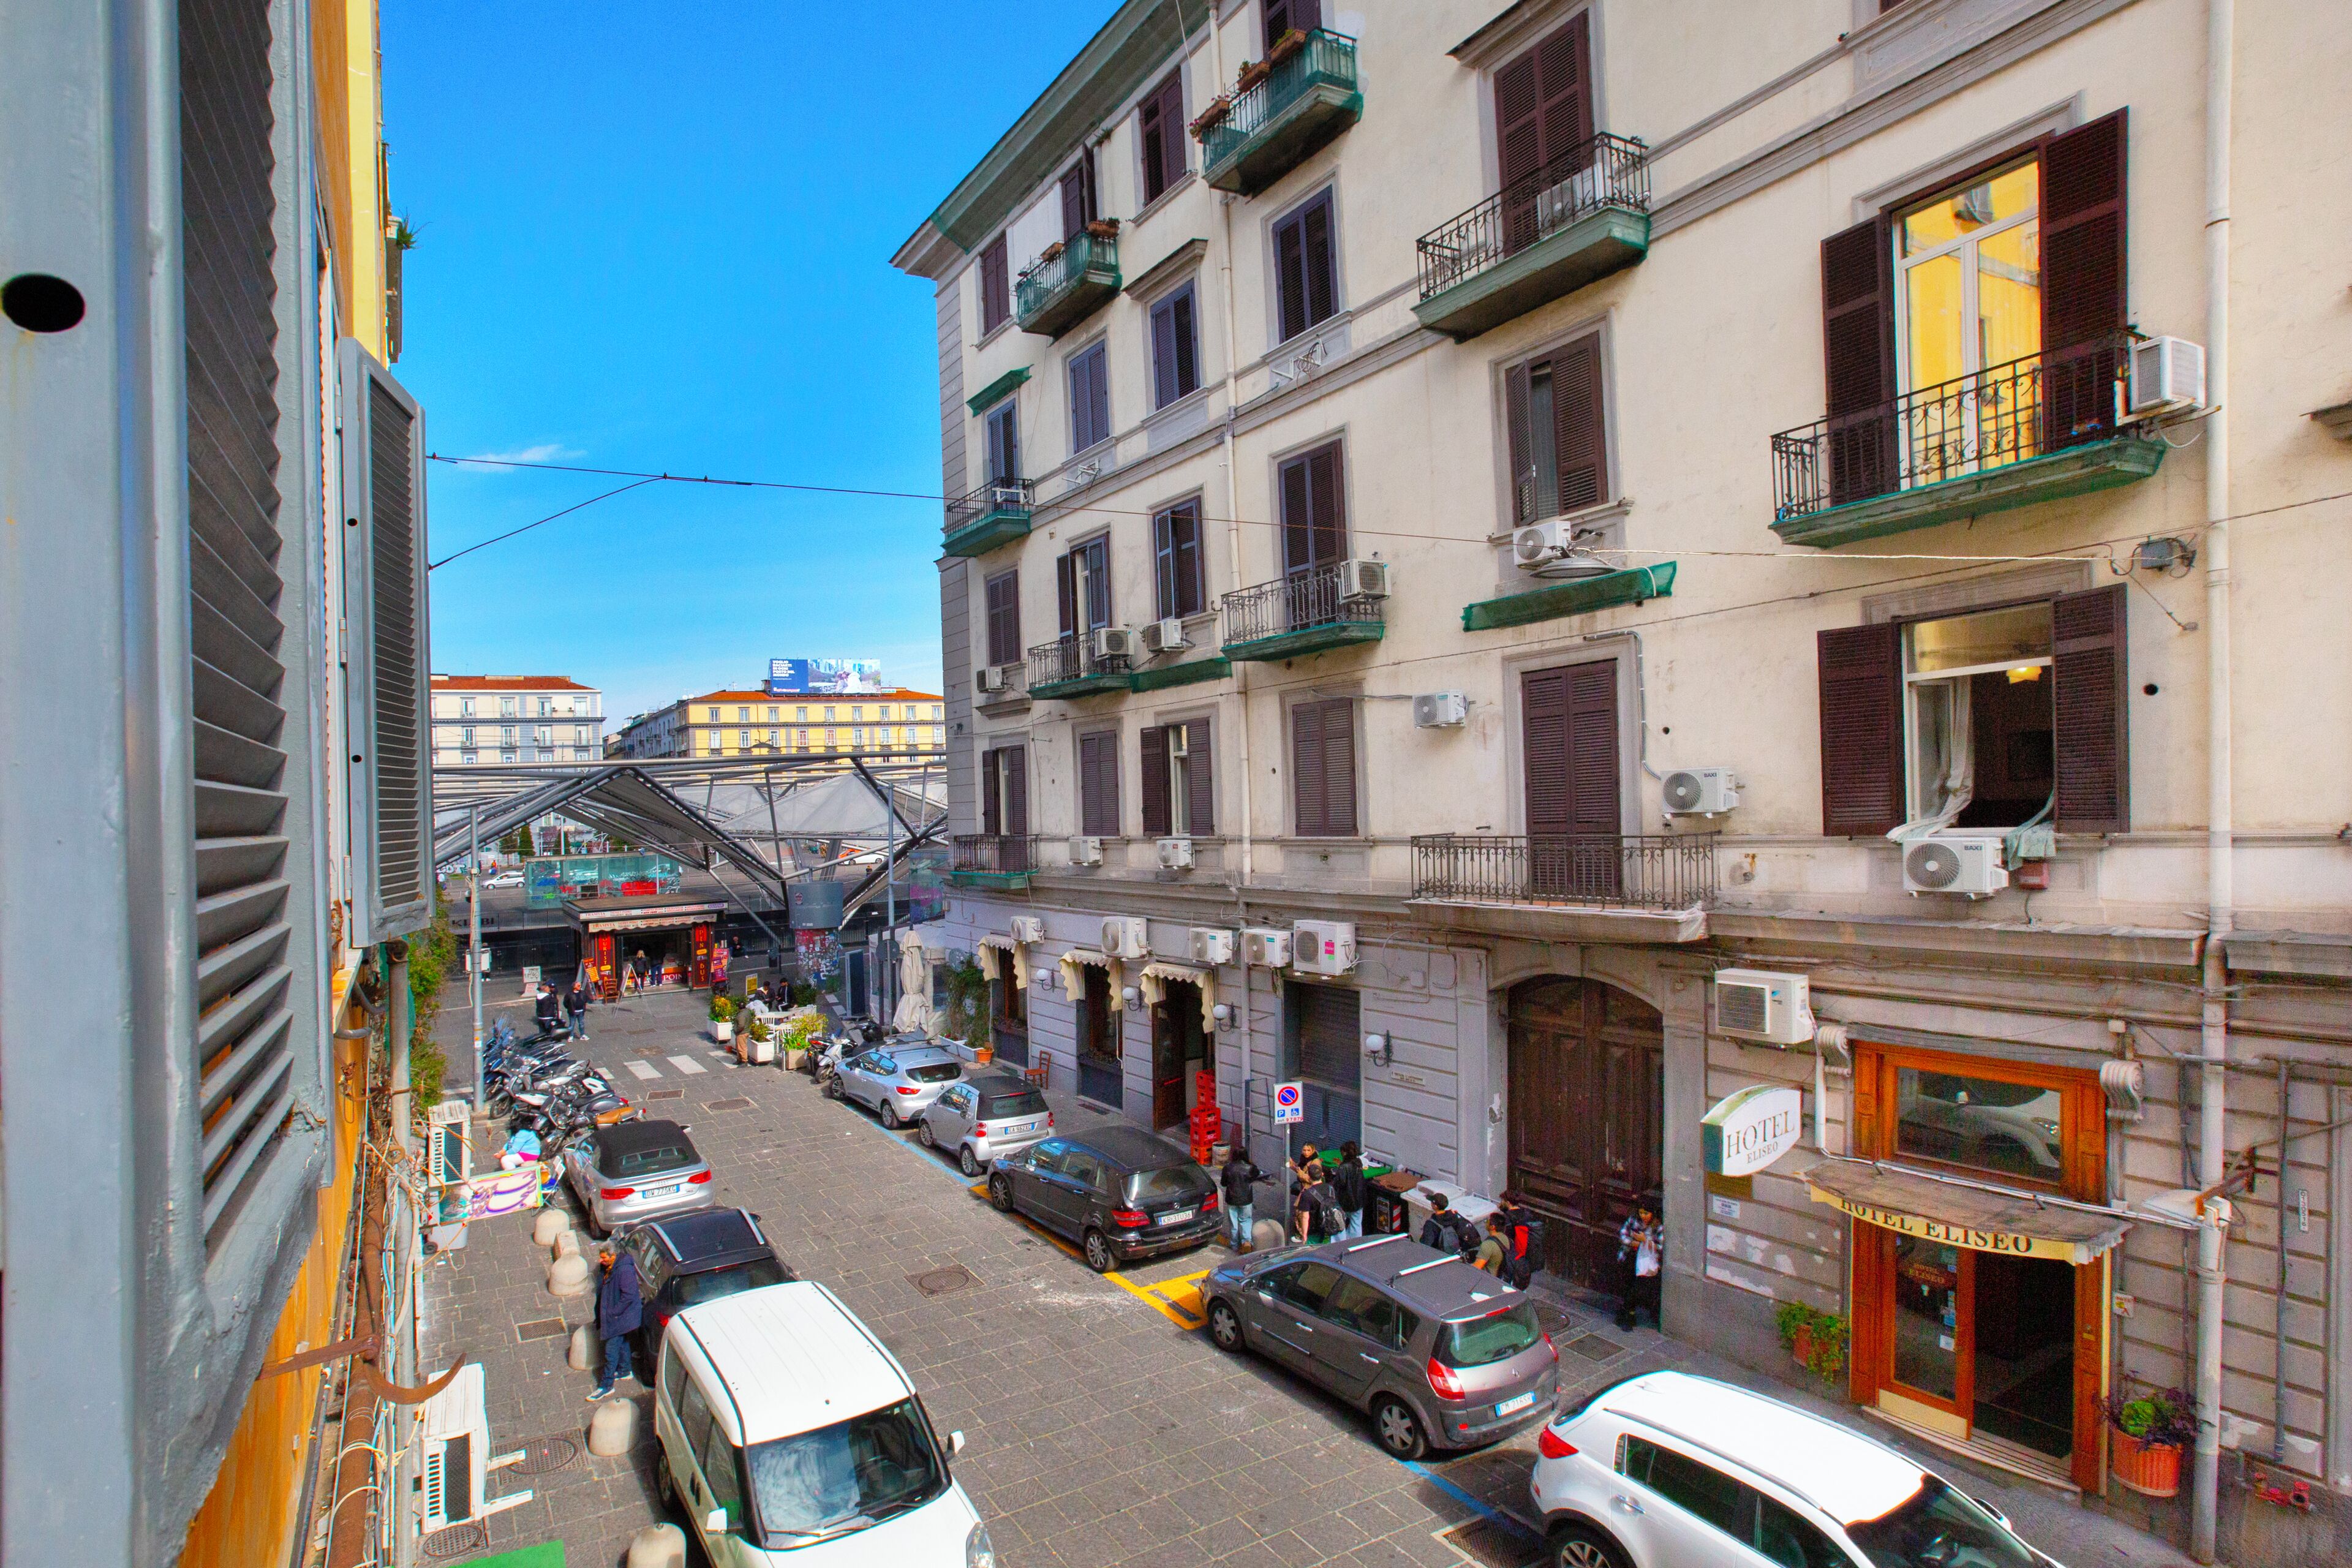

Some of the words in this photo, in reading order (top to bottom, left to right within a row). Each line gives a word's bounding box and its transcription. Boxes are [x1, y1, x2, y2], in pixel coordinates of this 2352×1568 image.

[452, 918, 494, 927] KIBI
[1726, 1110, 1795, 1159] HOTEL
[1747, 1141, 1778, 1164] ELISEO
[1173, 1212, 1191, 1221] 3TU36
[1841, 1199, 1913, 1231] HOTEL
[1924, 1222, 2032, 1253] ELISEO
